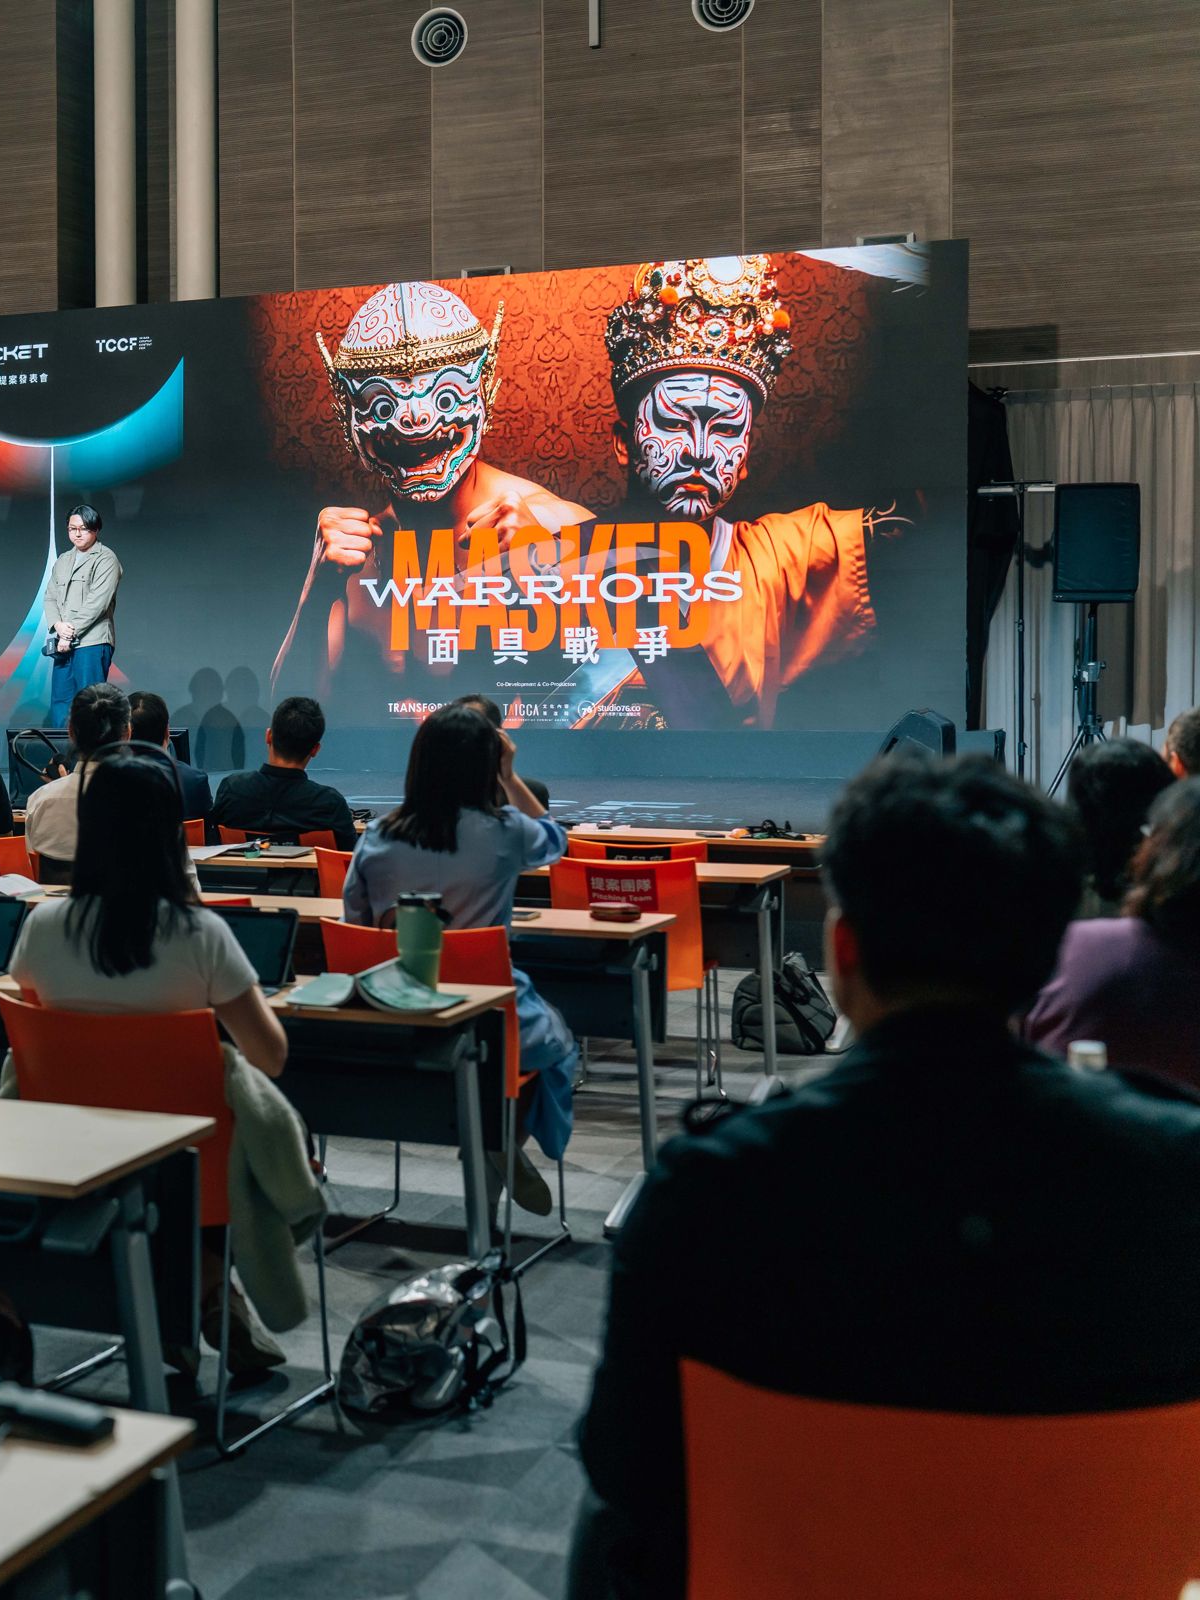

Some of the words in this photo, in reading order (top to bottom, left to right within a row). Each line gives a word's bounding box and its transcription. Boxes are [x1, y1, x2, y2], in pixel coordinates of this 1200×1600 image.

[95, 337, 138, 353] TCCF
[359, 570, 744, 608] WARRIORS
[390, 521, 711, 651] MASKED
[425, 625, 672, 665] 面具戰爭
[597, 703, 641, 712] studio76.co
[591, 877, 651, 892] 提案團隊
